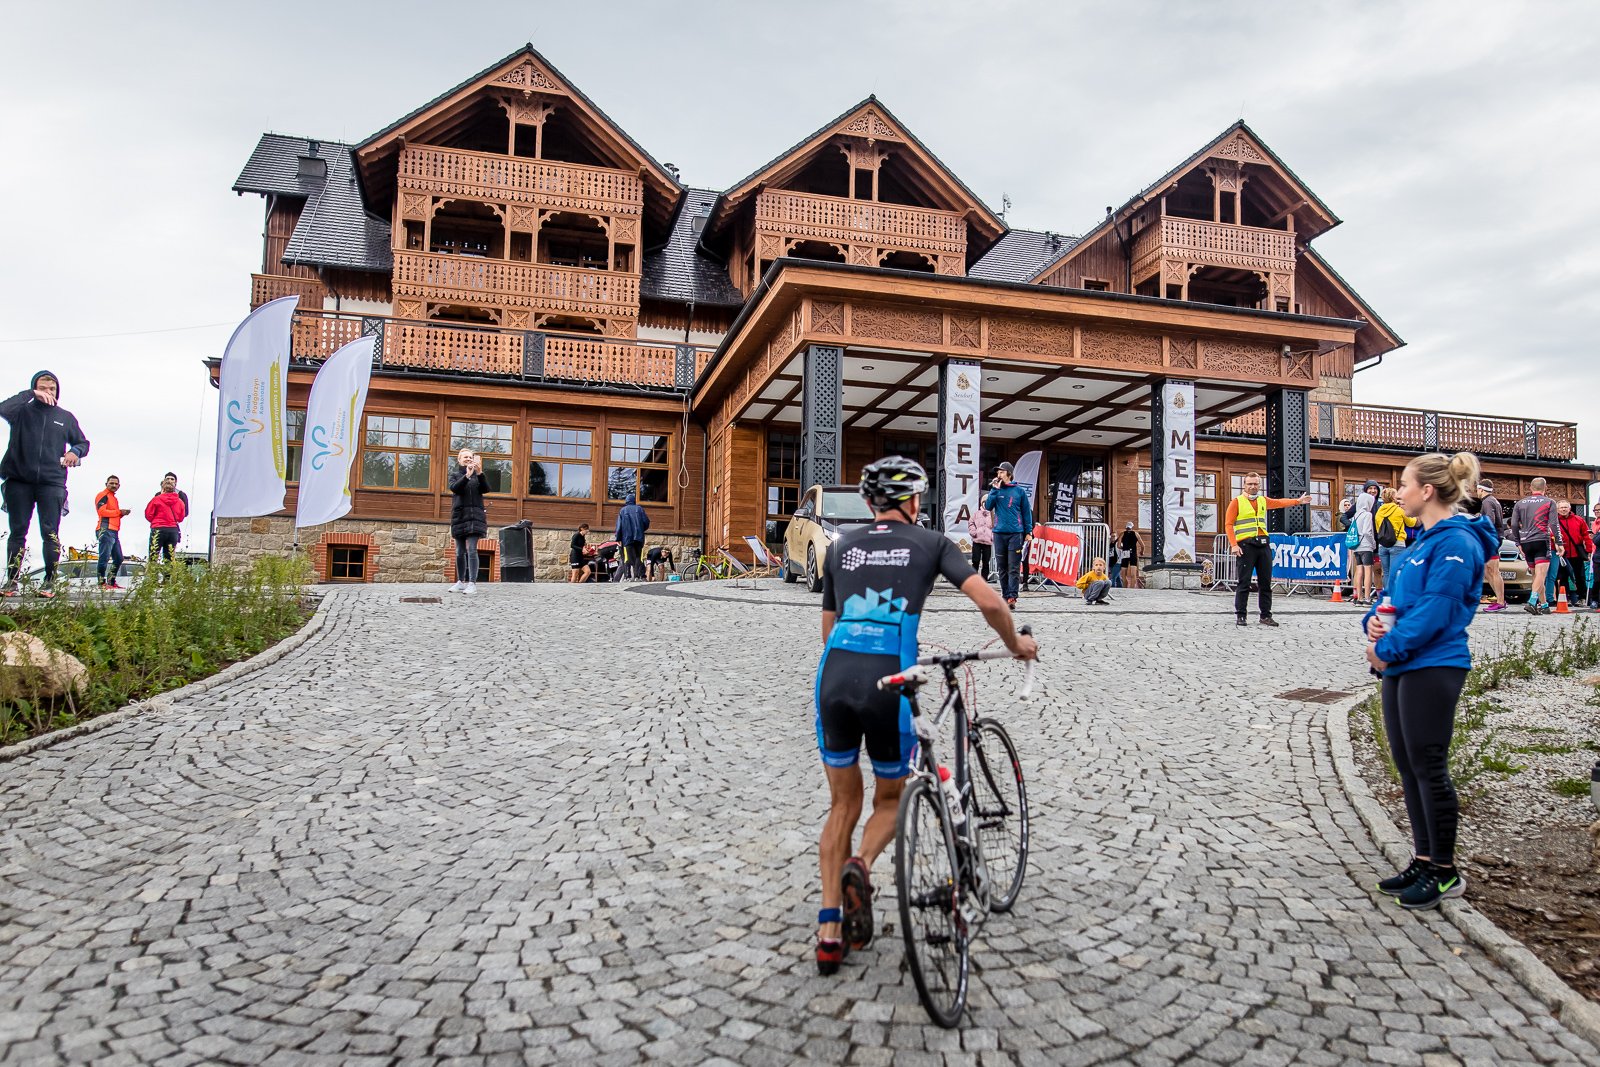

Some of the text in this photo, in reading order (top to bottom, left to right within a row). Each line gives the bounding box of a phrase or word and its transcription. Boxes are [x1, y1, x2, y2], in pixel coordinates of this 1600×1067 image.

[252, 378, 260, 414] Podgórzyn
[953, 413, 975, 525] META
[1171, 429, 1191, 536] META
[866, 548, 911, 558] JELCZ
[1028, 537, 1079, 576] ENERVIT
[1326, 569, 1341, 577] GÓRA
